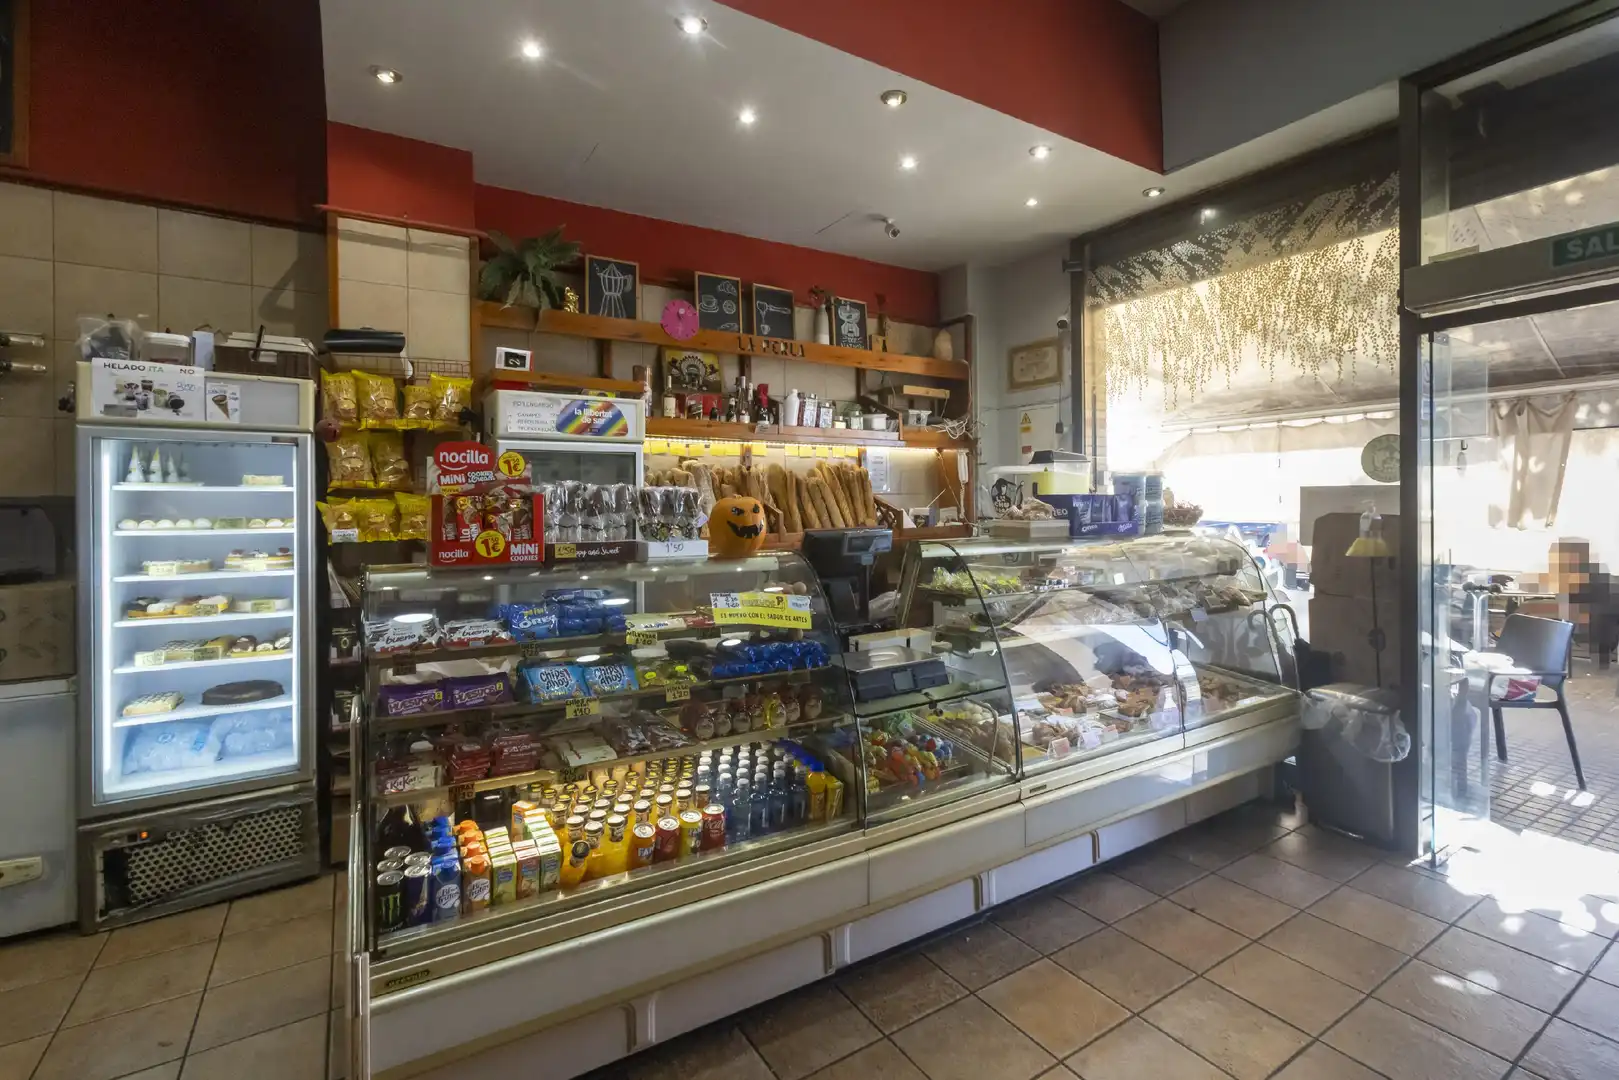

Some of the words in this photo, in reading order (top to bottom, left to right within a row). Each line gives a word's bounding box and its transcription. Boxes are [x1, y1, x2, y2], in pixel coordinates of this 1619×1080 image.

[738, 336, 754, 352] LA
[762, 340, 805, 357] PERLA
[103, 362, 146, 371] HELADO
[574, 408, 582, 416] la
[583, 408, 613, 418] llibertat
[440, 450, 489, 465] nocilla
[439, 548, 469, 559] nocilla
[600, 546, 621, 556] Sweet
[462, 628, 490, 637] bueno
[385, 634, 416, 645] bueno
[540, 669, 566, 684] Chips
